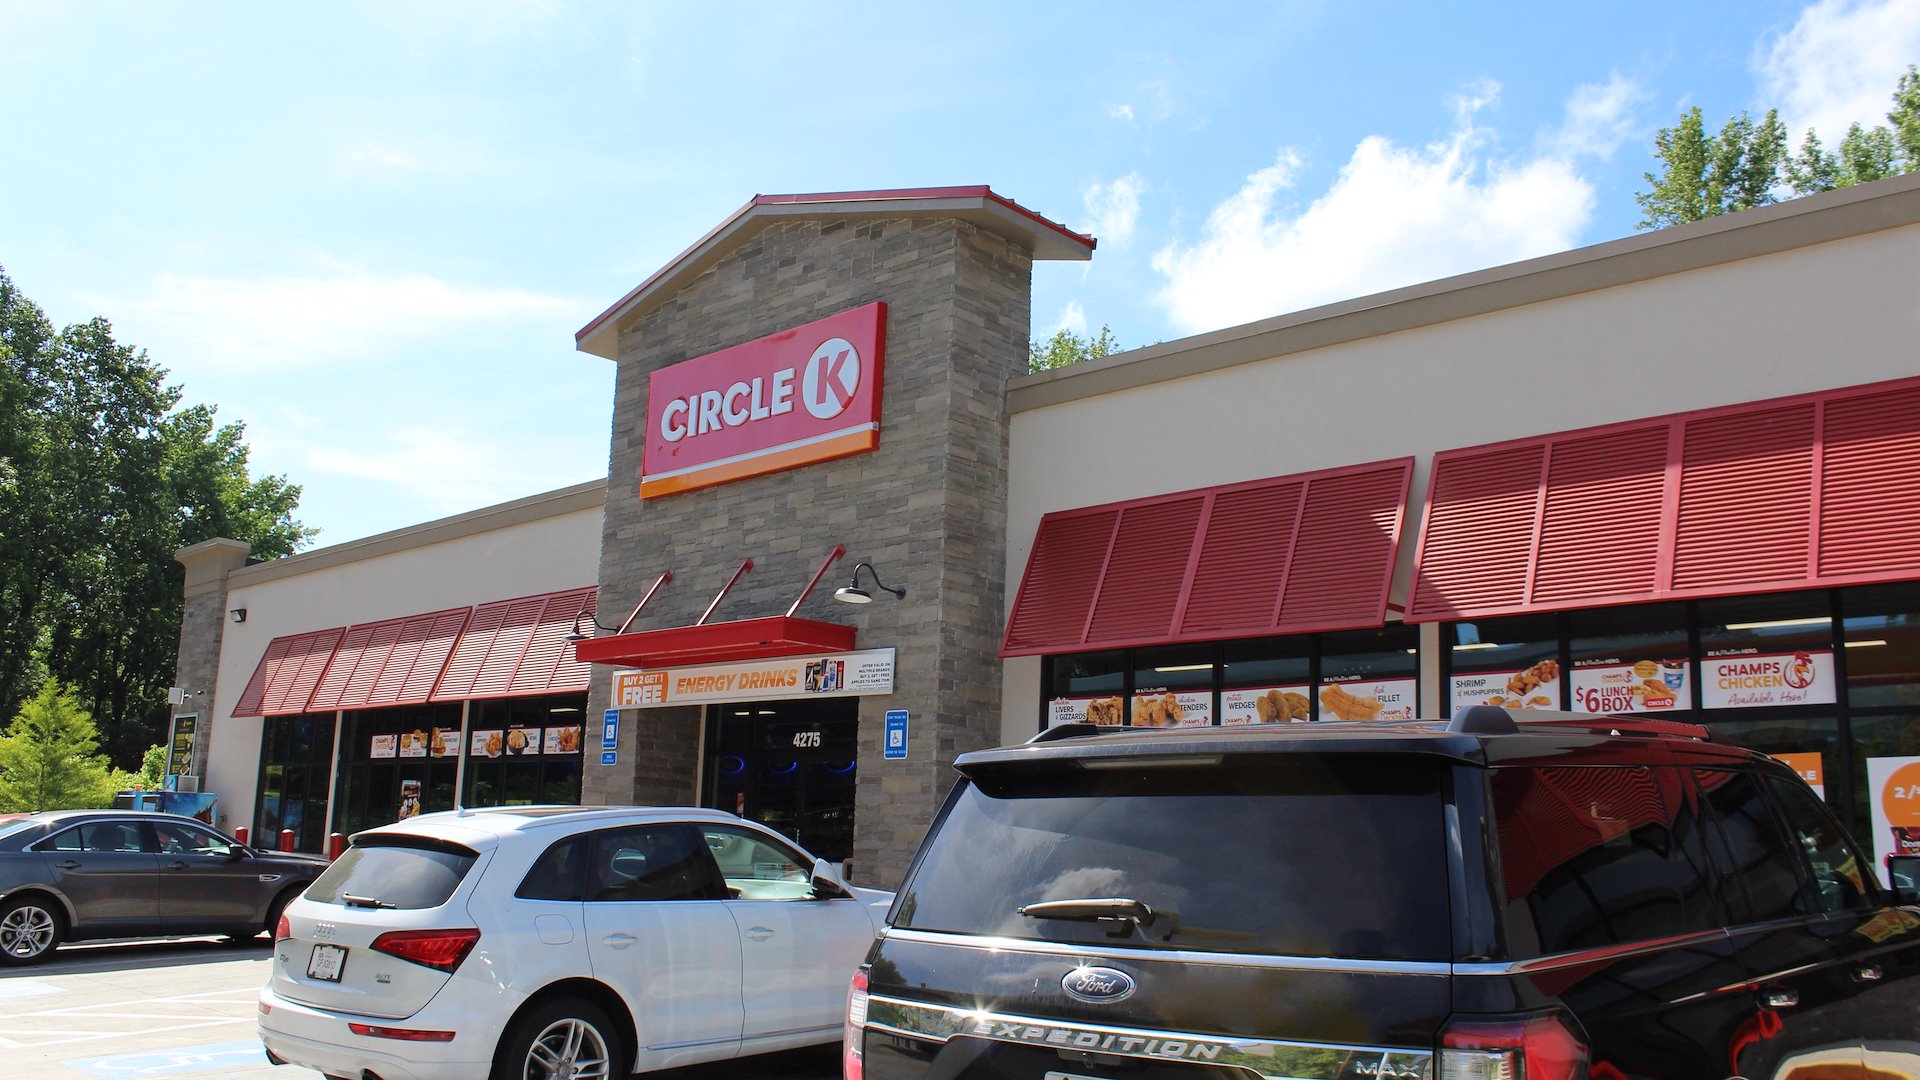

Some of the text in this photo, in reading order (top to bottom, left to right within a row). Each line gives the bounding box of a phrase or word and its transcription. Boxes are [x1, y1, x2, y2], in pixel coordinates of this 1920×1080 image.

[660, 367, 796, 442] CIRCLE
[1718, 662, 1780, 677] CHAMPS
[623, 674, 664, 686] BUY 2 GET 1
[675, 668, 798, 694] ENERGY DRINKS
[1456, 679, 1486, 688] SHRIMP
[1718, 675, 1783, 690] CHICKEN
[622, 685, 663, 705] FREE
[1377, 694, 1401, 703] FILLET
[1463, 688, 1505, 697] HUSHPUPPIES
[1575, 685, 1634, 713] $6 BOX
[1601, 686, 1634, 698] LUNCH
[1180, 703, 1208, 712] TENDERS
[1228, 701, 1256, 710] WEDGES
[1060, 712, 1087, 720] GIZZARDS
[792, 732, 820, 748] 4275
[1076, 972, 1114, 994] Ford
[973, 1020, 1222, 1059] EXPEDITION
[1356, 1061, 1420, 1078] MAX
